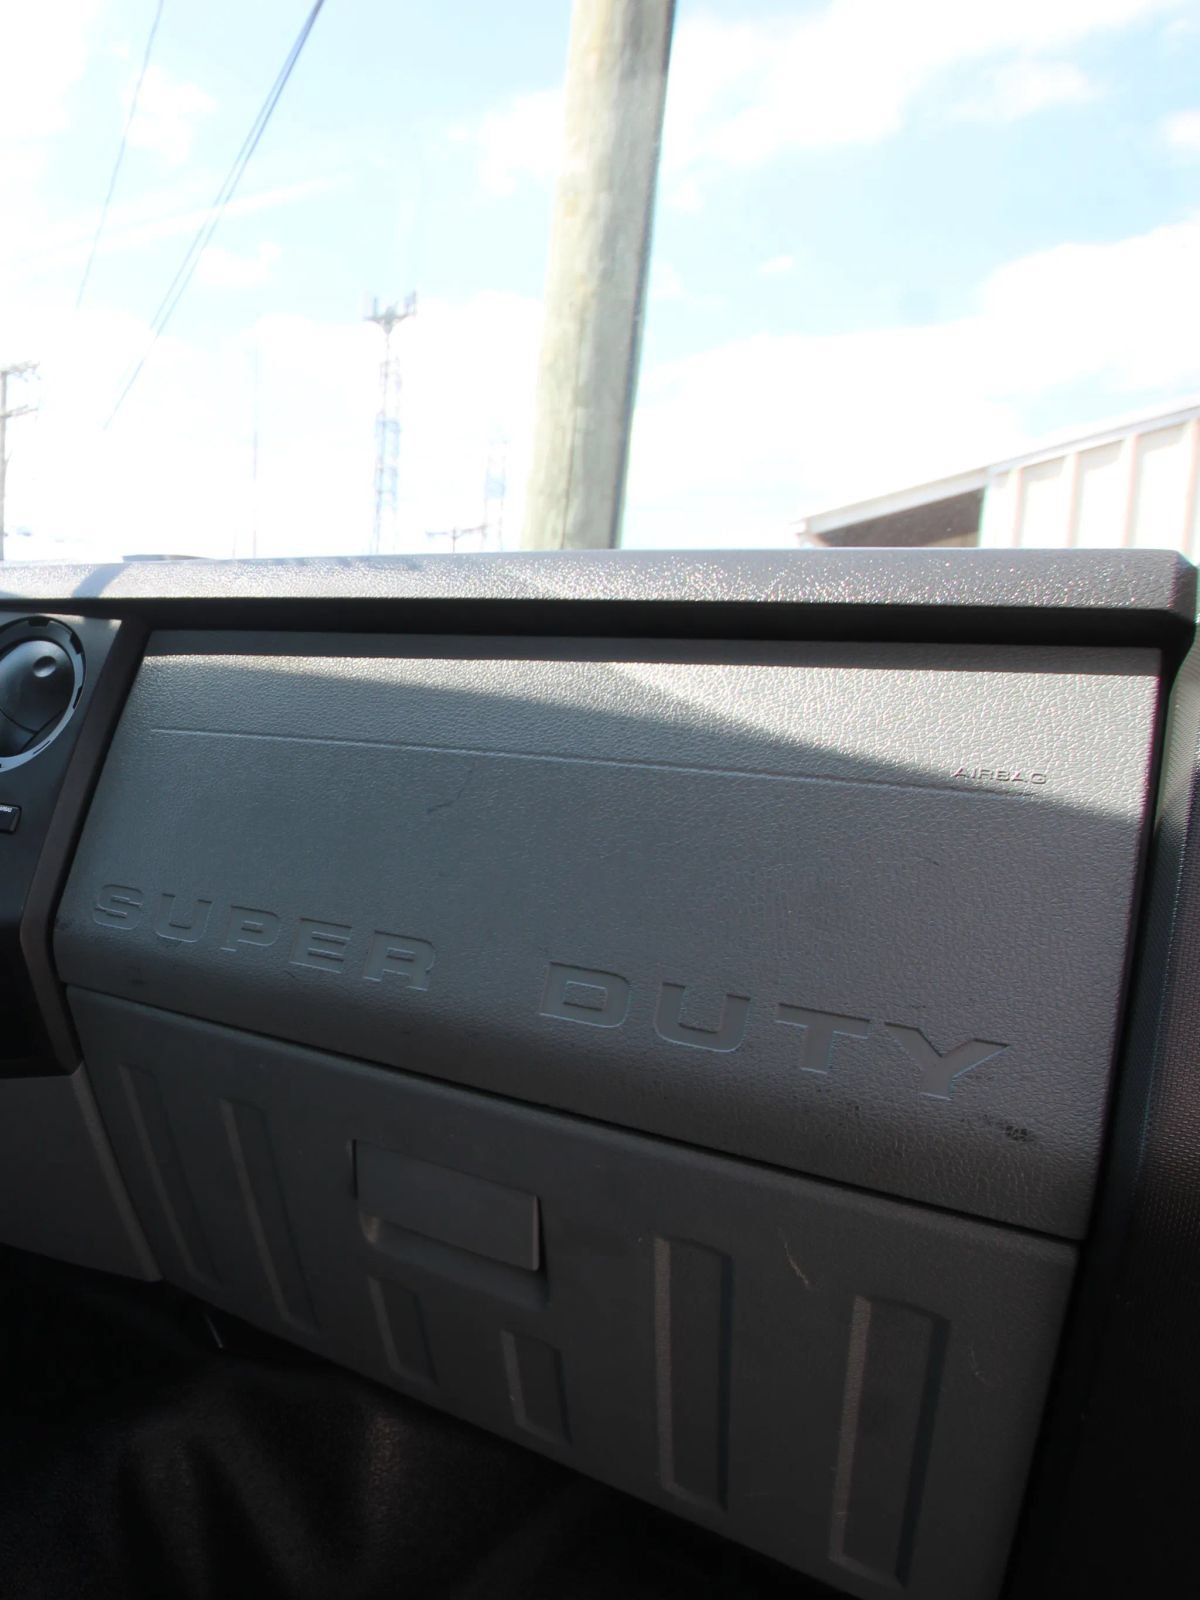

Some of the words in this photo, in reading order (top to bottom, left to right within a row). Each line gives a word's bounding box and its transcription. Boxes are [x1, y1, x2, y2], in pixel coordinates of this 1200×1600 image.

[951, 767, 1048, 785] AIRBAG
[92, 883, 437, 992] SUPER
[538, 961, 1011, 1101] DUTY
